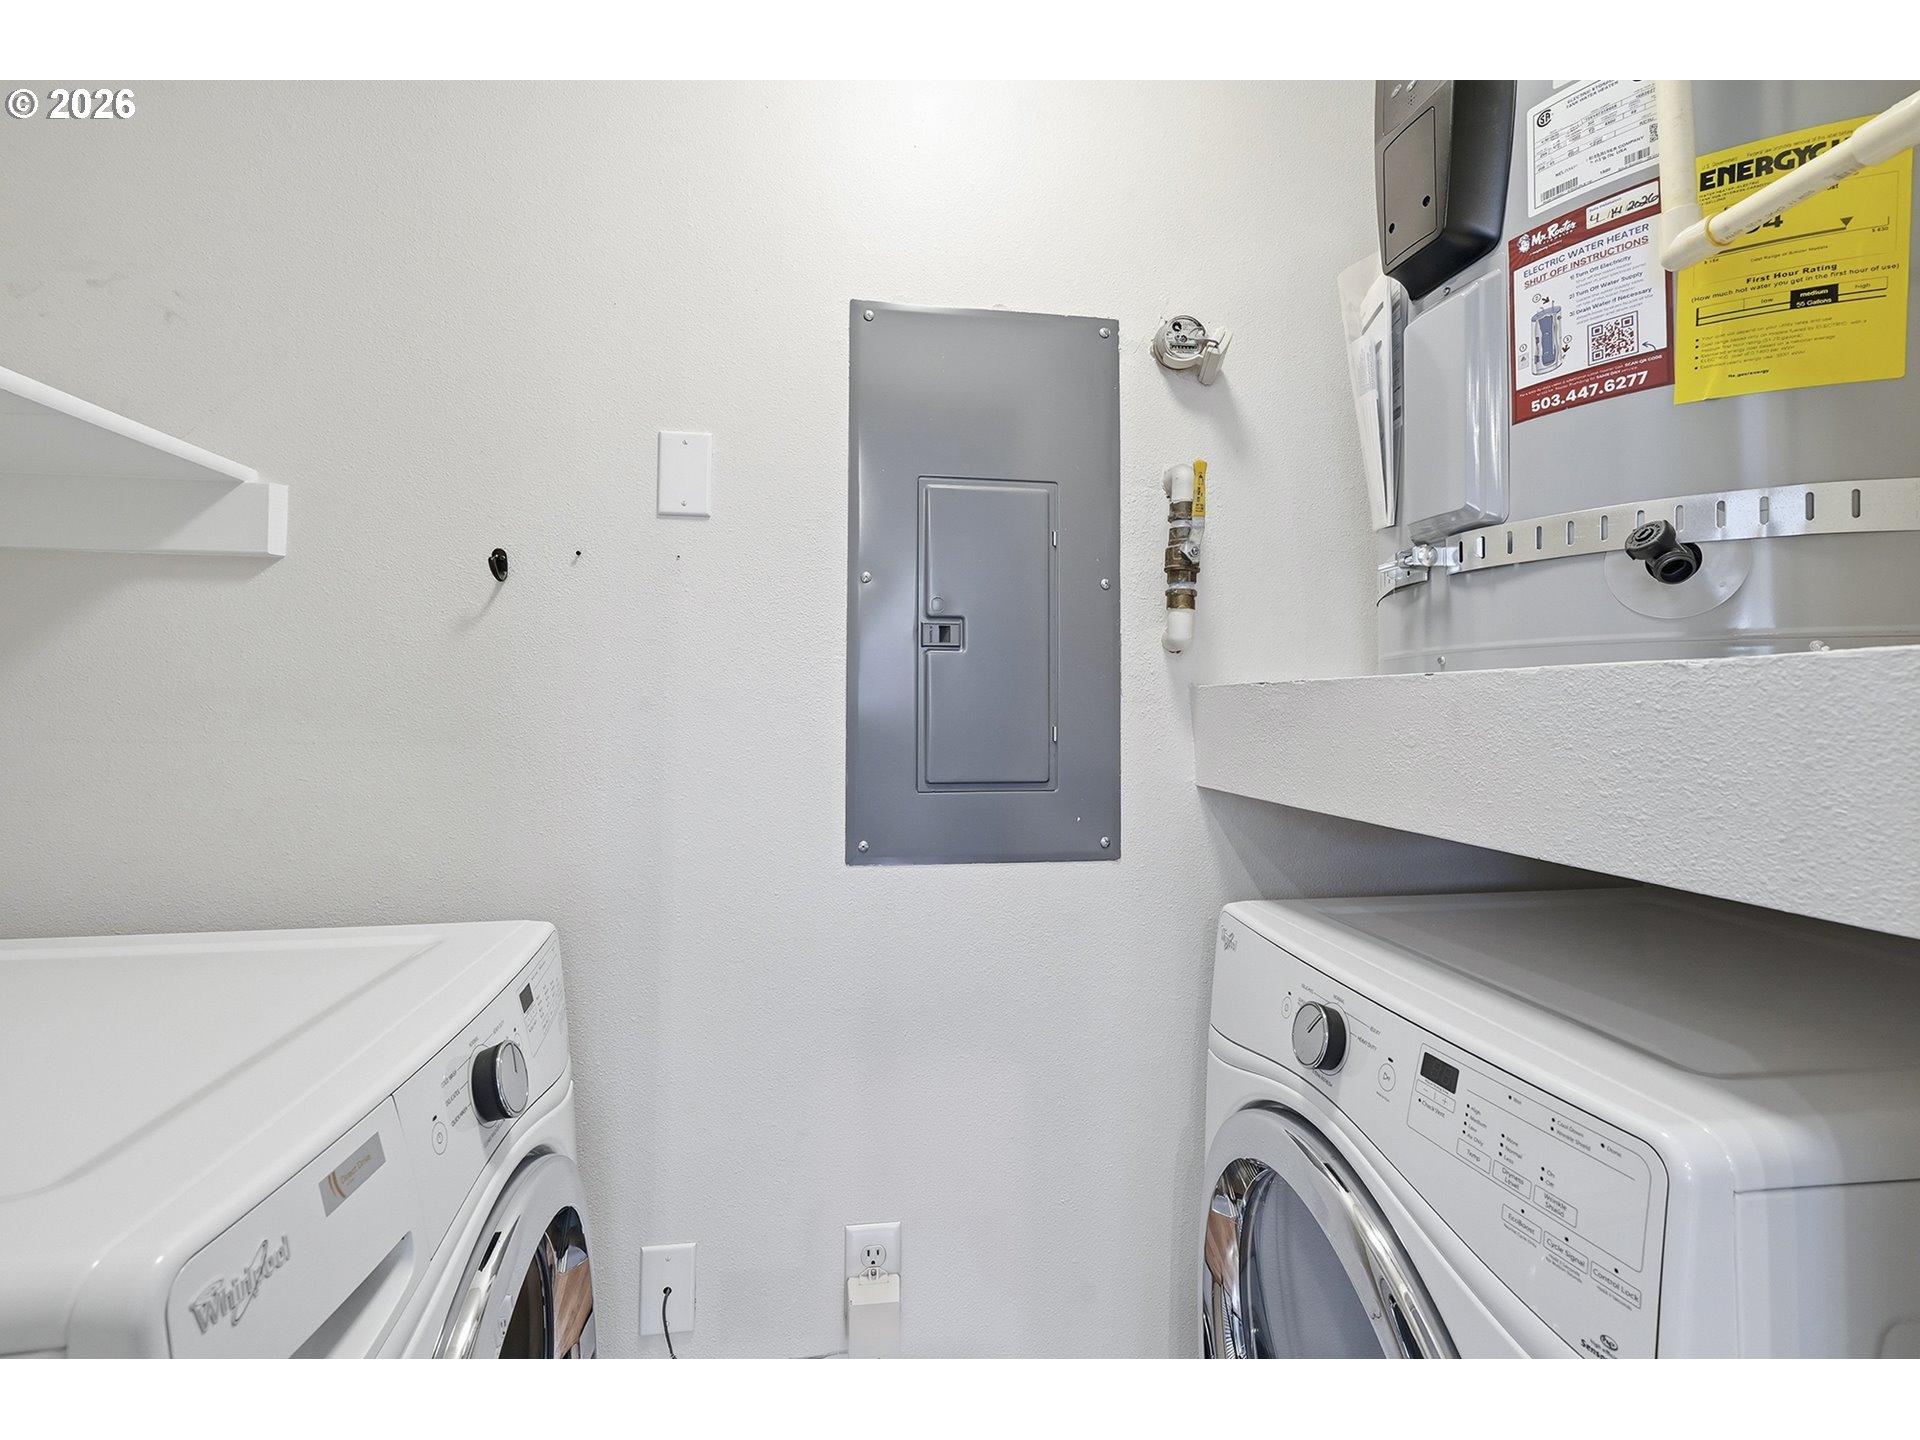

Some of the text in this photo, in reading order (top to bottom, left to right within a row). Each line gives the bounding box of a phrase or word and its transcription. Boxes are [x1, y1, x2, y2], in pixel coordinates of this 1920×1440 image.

[1523, 254, 1566, 278] ELECTRIC
[1567, 239, 1604, 259] WATER
[1606, 223, 1650, 245] HEATER
[1524, 272, 1548, 289] SHUT
[1550, 264, 1568, 279] OFF
[1570, 235, 1649, 270] INSTRUCTIONS
[1576, 270, 1588, 279] Turn
[1600, 255, 1632, 270] Electricity
[1746, 263, 1838, 284] First Hour Rating
[1576, 289, 1588, 297] Turn
[1600, 278, 1620, 288] Water
[1621, 271, 1643, 281] Supply
[1691, 294, 1710, 304] (How
[1711, 289, 1734, 298] much
[1735, 286, 1747, 294] hot
[1749, 283, 1773, 291] water
[1773, 280, 1788, 289] you
[1790, 277, 1805, 286] get
[1814, 273, 1829, 281] the
[1830, 270, 1848, 279] first
[1849, 267, 1869, 276] hour
[1881, 263, 1900, 271] use)
[1799, 288, 1829, 298] medium
[1576, 305, 1591, 315] Drain
[1592, 299, 1611, 310] Water
[1617, 287, 1652, 301] Necessary
[1806, 297, 1832, 307] Gallons
[1531, 370, 1648, 413] 503.447.6277
[1467, 1148, 1481, 1162] Temp
[1502, 1166, 1524, 1186] Dryness
[1544, 1192, 1567, 1211] Wrinkle
[1545, 1201, 1565, 1218] Shield
[1508, 1212, 1535, 1235] EcoBoost
[1546, 1238, 1586, 1268] Cycle Signal
[189, 1236, 290, 1335] Whirlpool
[1592, 1268, 1639, 1303] Control Lock
